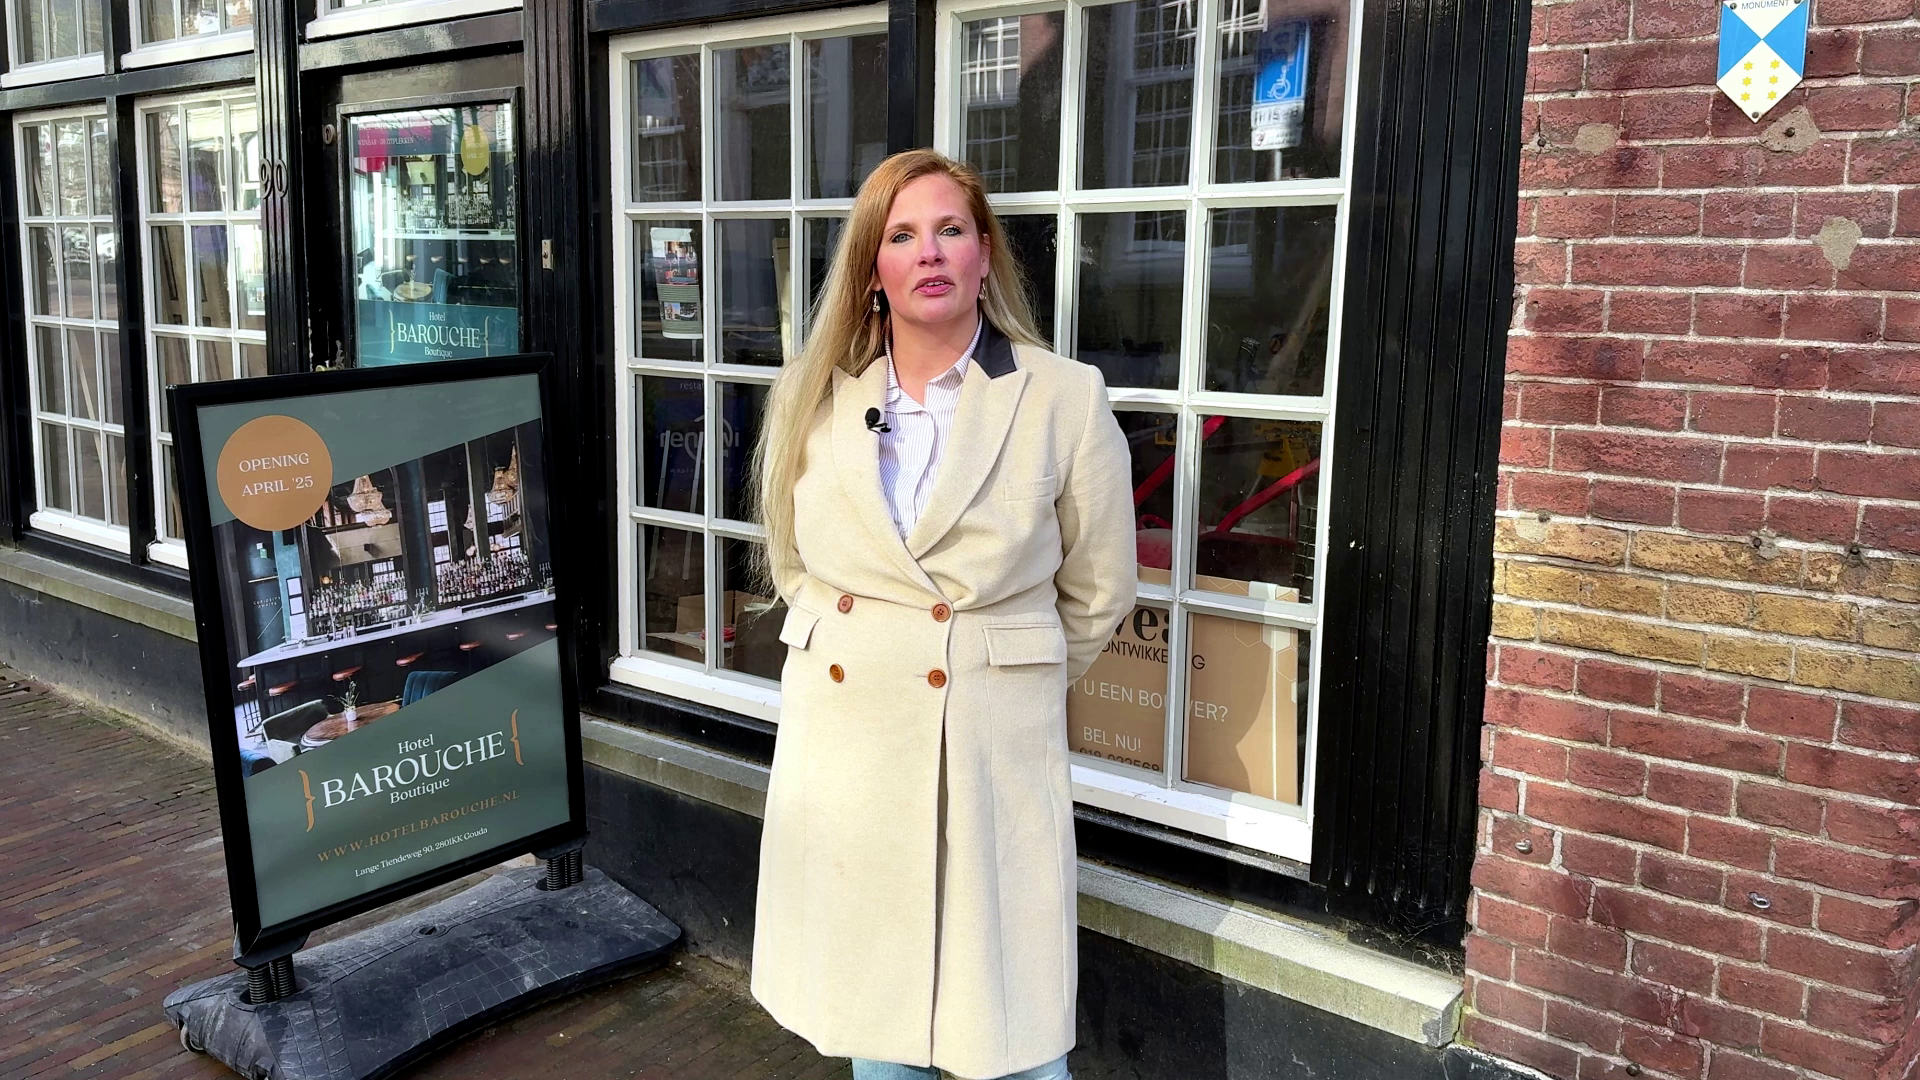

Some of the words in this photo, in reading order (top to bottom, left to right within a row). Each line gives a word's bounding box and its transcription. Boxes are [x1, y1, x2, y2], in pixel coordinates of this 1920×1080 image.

[1741, 0, 1789, 10] MONUMENT
[260, 157, 288, 199] 90
[429, 311, 446, 322] Hotel
[396, 322, 481, 348] BAROUCHE
[424, 346, 453, 359] Boutique
[239, 452, 310, 473] OPENING
[241, 479, 290, 497] APRIL
[292, 475, 314, 489] '25
[1084, 679, 1095, 696] U
[1100, 682, 1133, 704] EEN
[1138, 689, 1229, 723] BOER?
[397, 733, 435, 755] Hotel
[1083, 726, 1111, 746] BEL
[1115, 733, 1142, 753] NU!
[321, 730, 506, 809] BAROUCHE
[389, 777, 451, 805] Boutique
[317, 790, 520, 863] WWW.HOTELBAROUCHE.NL
[355, 863, 380, 878] Lange
[380, 848, 423, 869] Tiendeweg
[435, 834, 463, 850] 2801KK
[463, 826, 488, 840] Gouda
